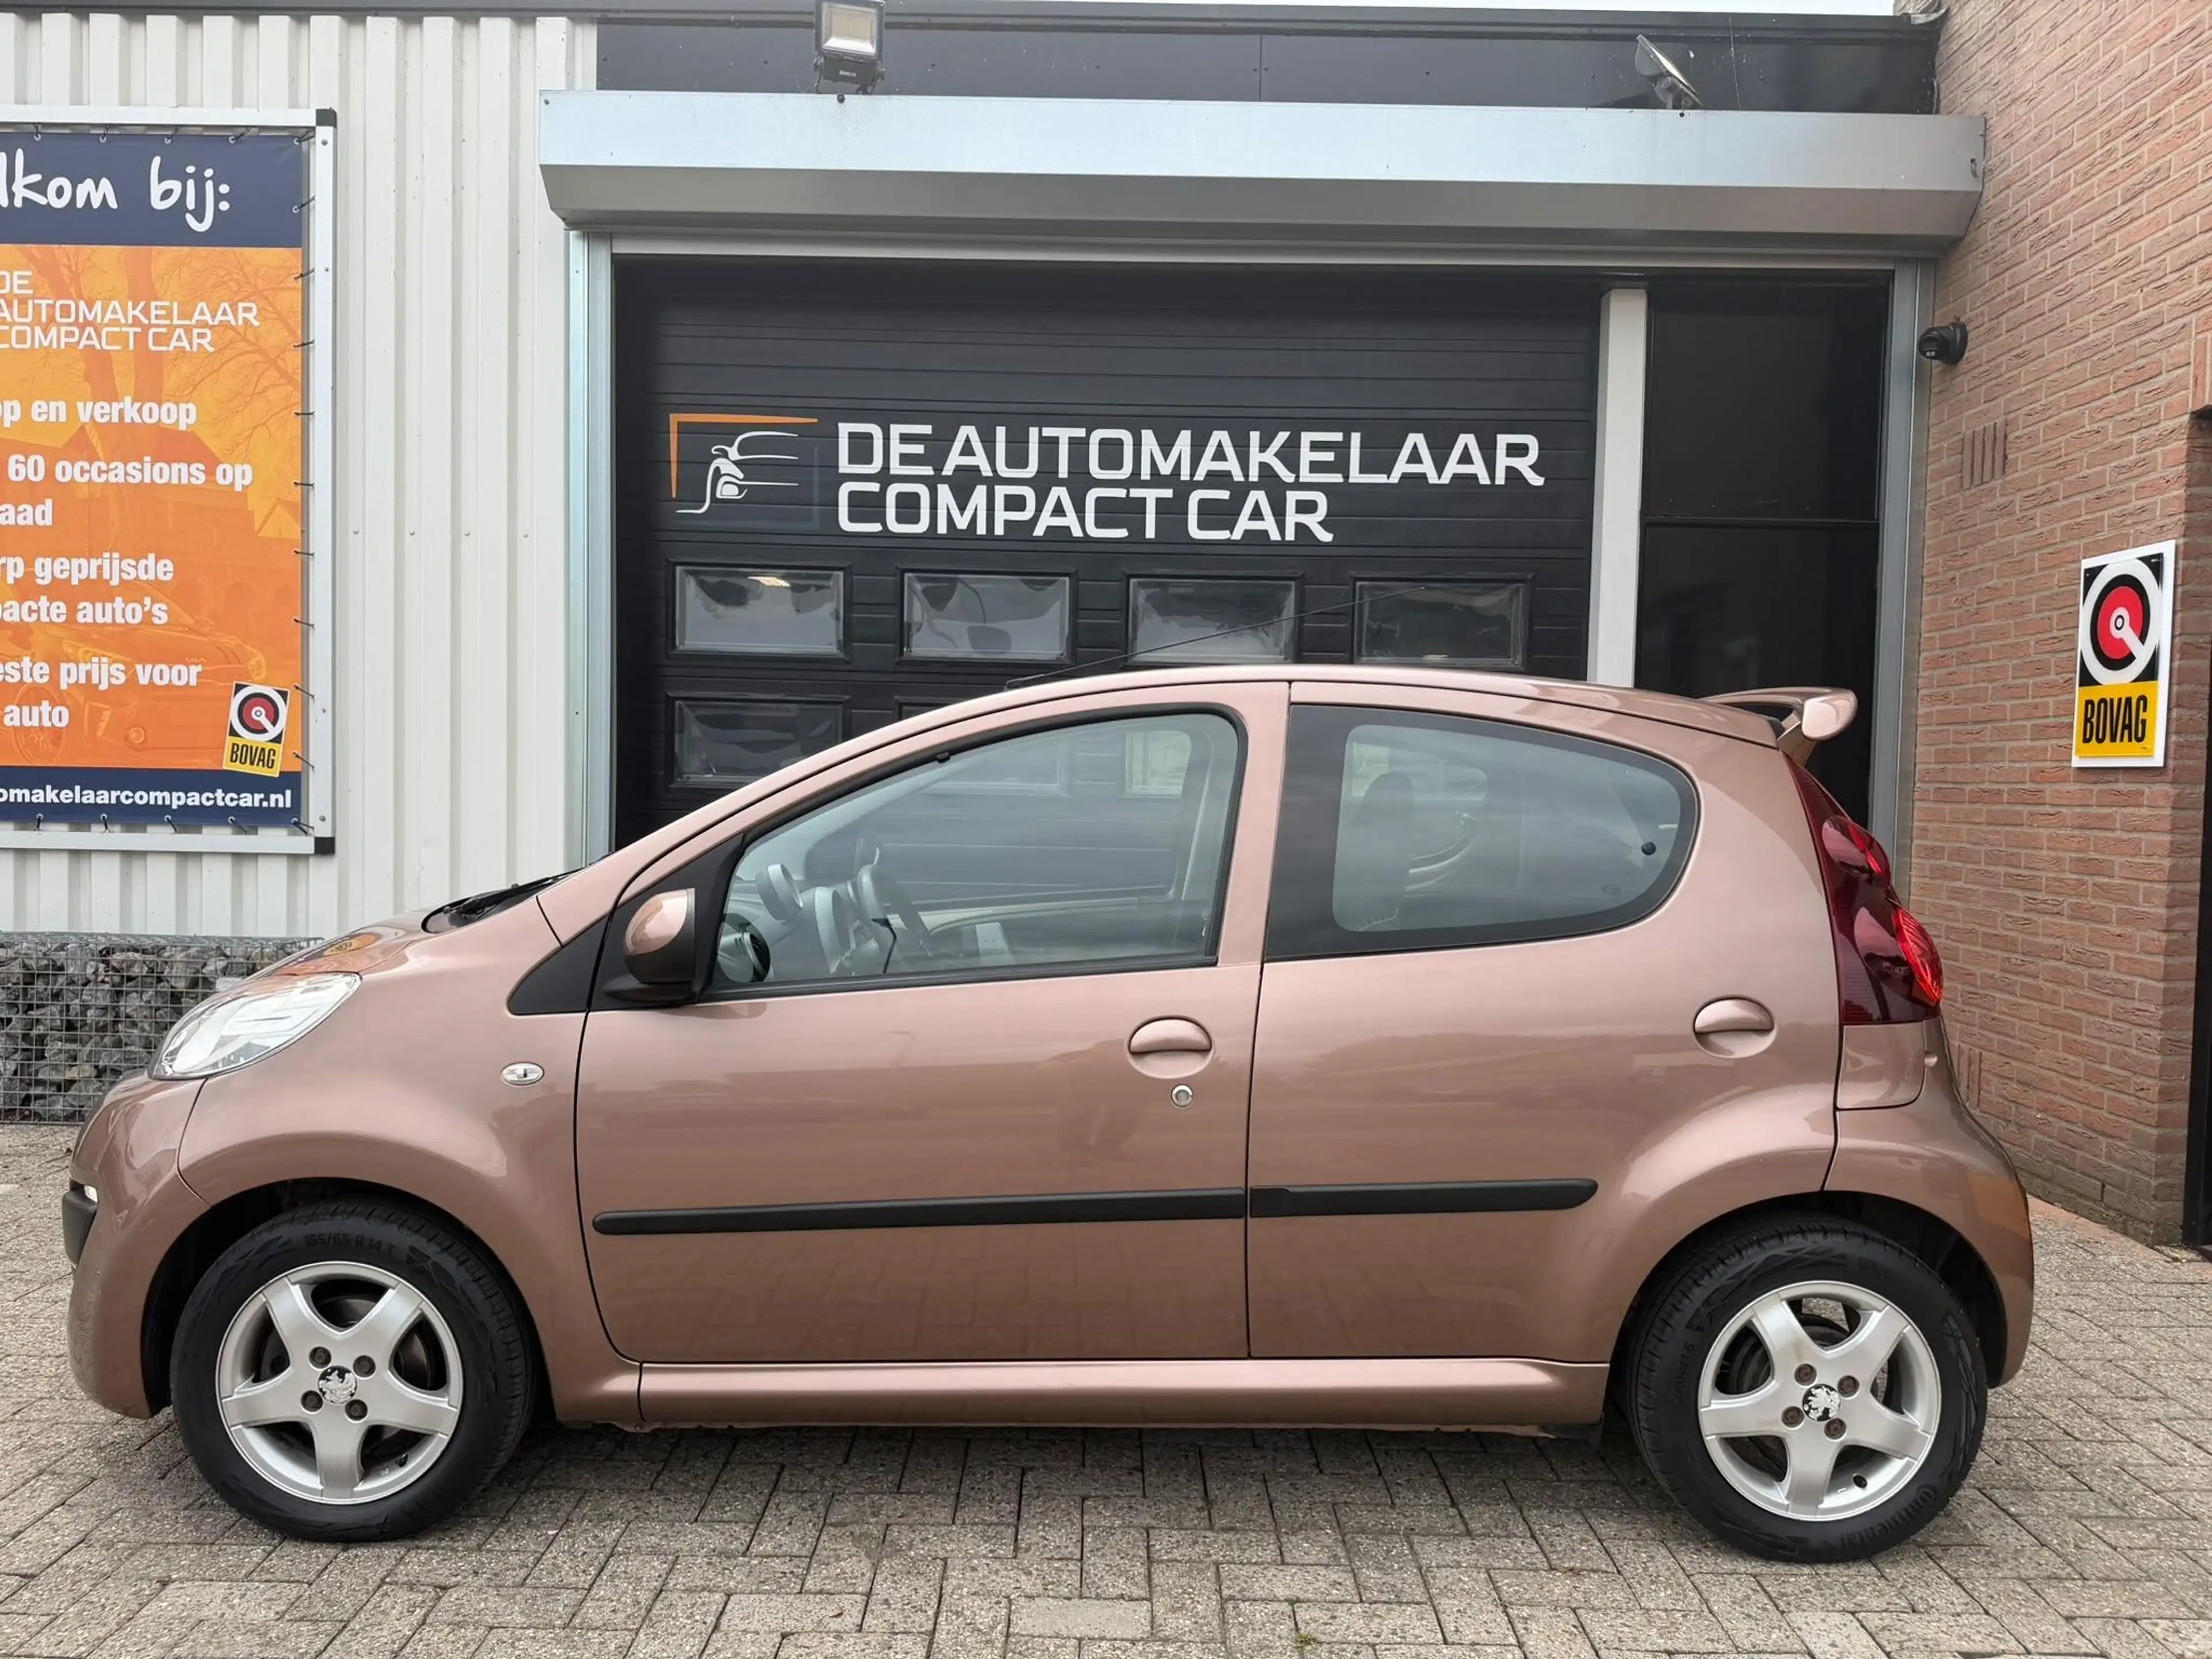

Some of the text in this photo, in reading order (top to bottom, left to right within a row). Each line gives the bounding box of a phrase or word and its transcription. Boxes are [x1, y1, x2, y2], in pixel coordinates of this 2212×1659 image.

[0, 147, 230, 232] lkom bij:
[147, 328, 215, 352] CAR
[0, 396, 197, 431] p en verkoop
[8, 454, 253, 492] 60 occasions op
[838, 482, 1334, 542] COMPACT CAR
[35, 552, 174, 586] geprijsde
[0, 596, 168, 626] acte auto's
[0, 656, 202, 691] ste prijs voor
[3, 700, 70, 728] auto
[2082, 694, 2148, 744] BOVAG
[230, 743, 276, 769] BOVAG
[305, 1233, 351, 1246] 155/65
[355, 1235, 365, 1248] R
